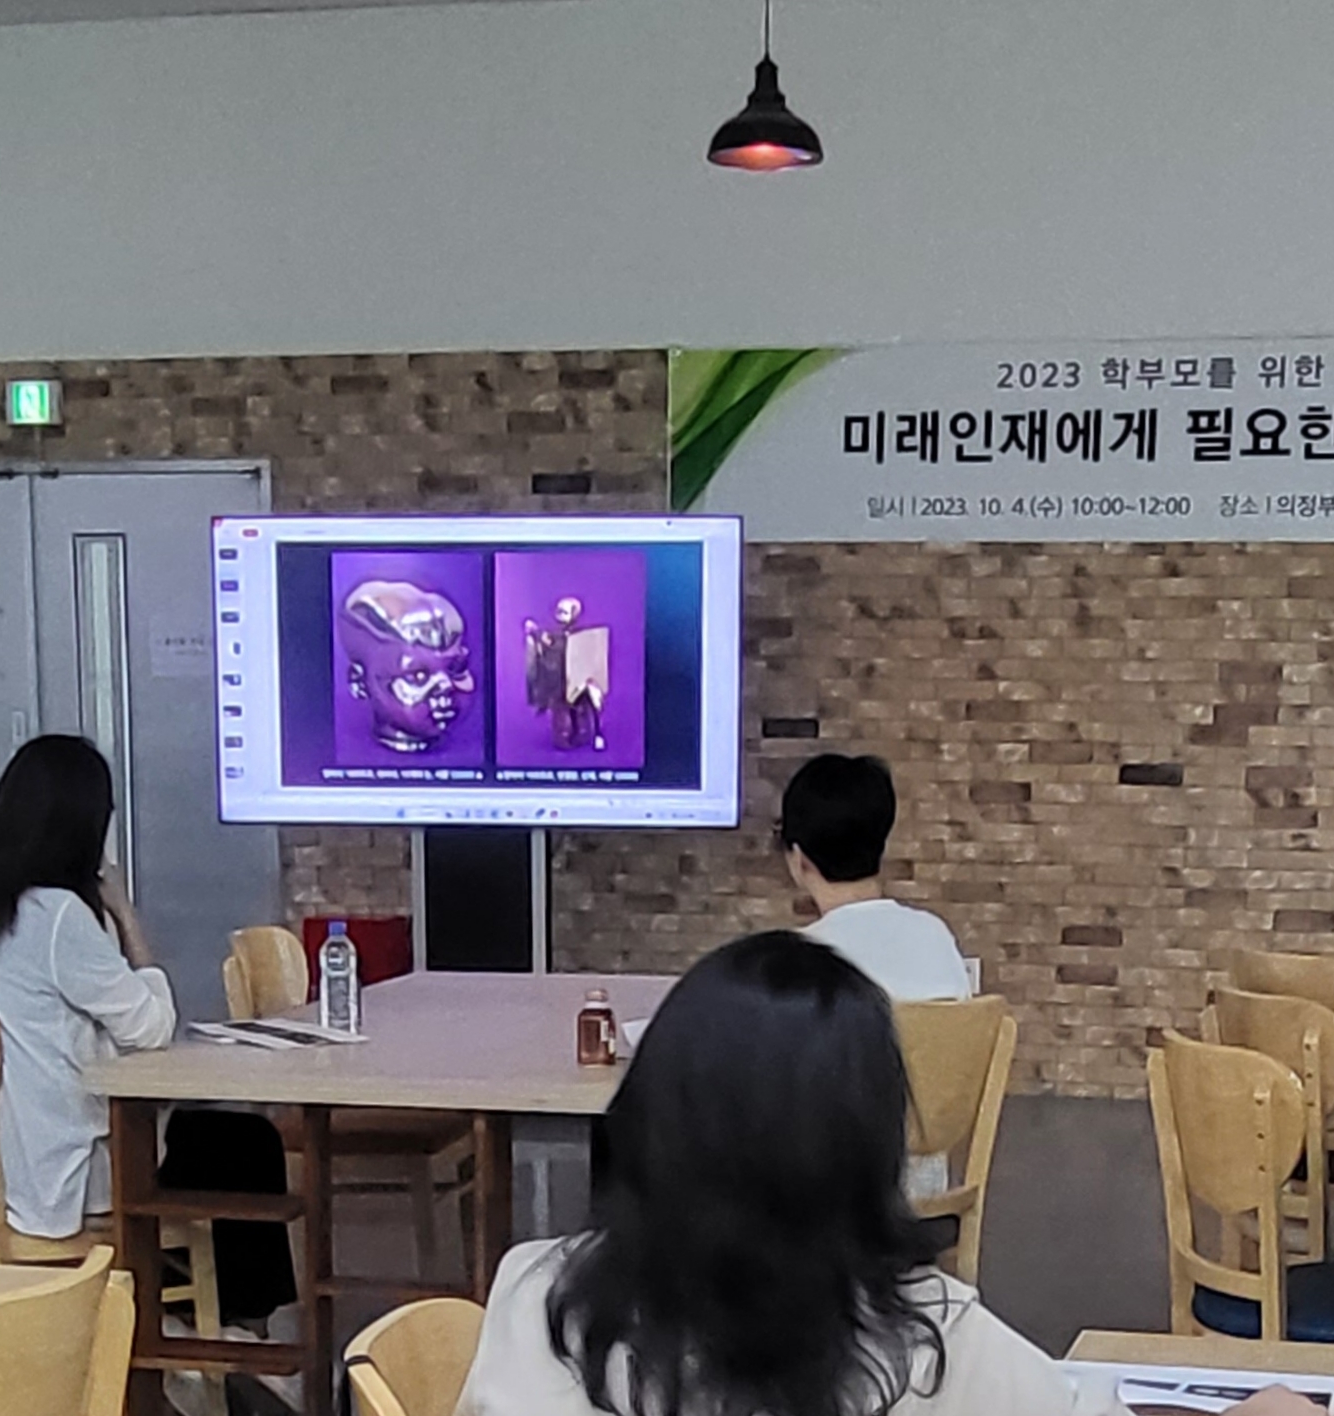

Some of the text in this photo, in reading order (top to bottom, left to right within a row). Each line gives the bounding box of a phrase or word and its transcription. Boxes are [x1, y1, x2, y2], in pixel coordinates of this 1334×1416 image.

[997, 361, 1081, 389] 2023
[1101, 356, 1237, 390] 학부모를
[1258, 354, 1326, 389] 위한
[842, 407, 1160, 464] 미래인재에게
[1071, 496, 1192, 516] 10:00~12:00
